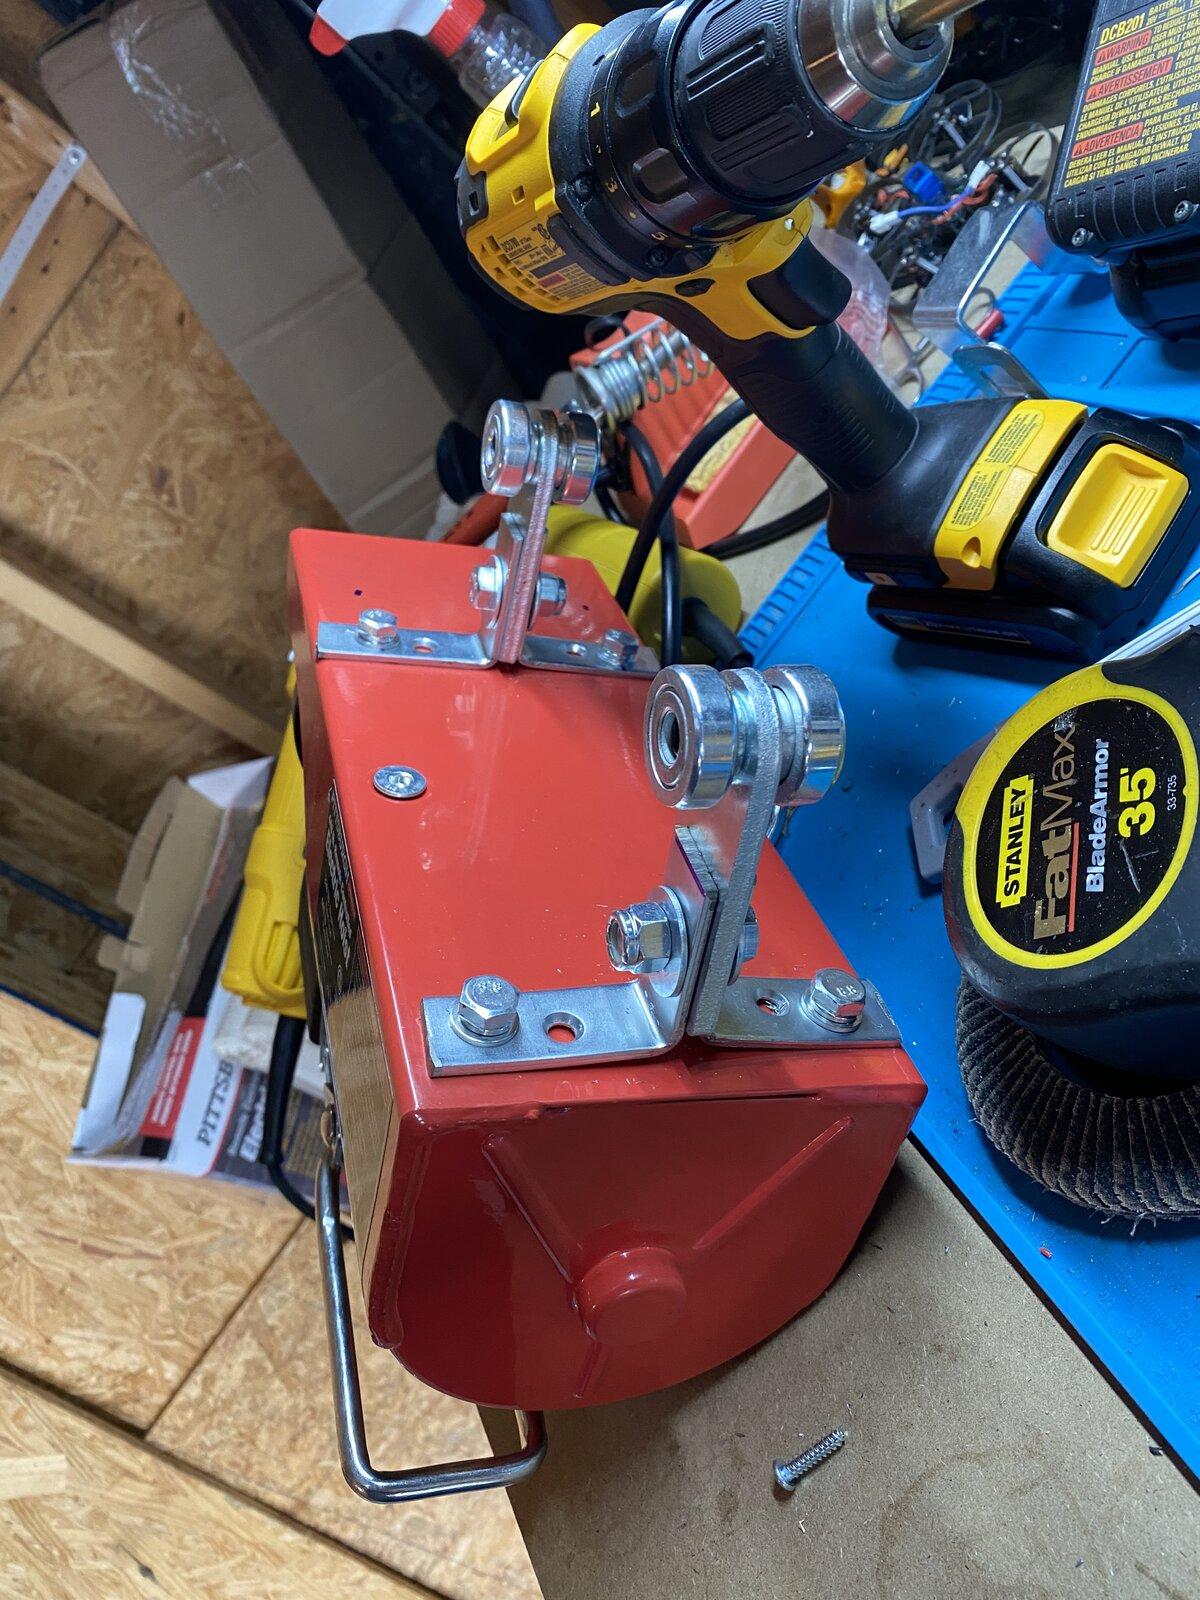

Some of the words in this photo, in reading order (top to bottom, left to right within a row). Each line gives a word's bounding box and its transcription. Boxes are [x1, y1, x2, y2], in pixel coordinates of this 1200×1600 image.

[1100, 12, 1145, 44] DCB201
[1162, 14, 1185, 30] REDUCE
[1167, 23, 1186, 37] MUST
[1105, 32, 1149, 59] WARNING
[1121, 52, 1135, 64] USE
[1135, 45, 1152, 58] WITH
[1152, 34, 1180, 52] DEWALT
[1167, 42, 1182, 55] NOT
[1096, 59, 1170, 96] AVERTISSEMENT
[1083, 125, 1139, 152] ADVERTENCIA
[1063, 173, 1088, 187] CARGAR
[1167, 774, 1177, 811] 33-735
[1085, 738, 1109, 892] BladeArmor
[1004, 787, 1026, 897] STANLEY
[1033, 724, 1076, 940] FatMax
